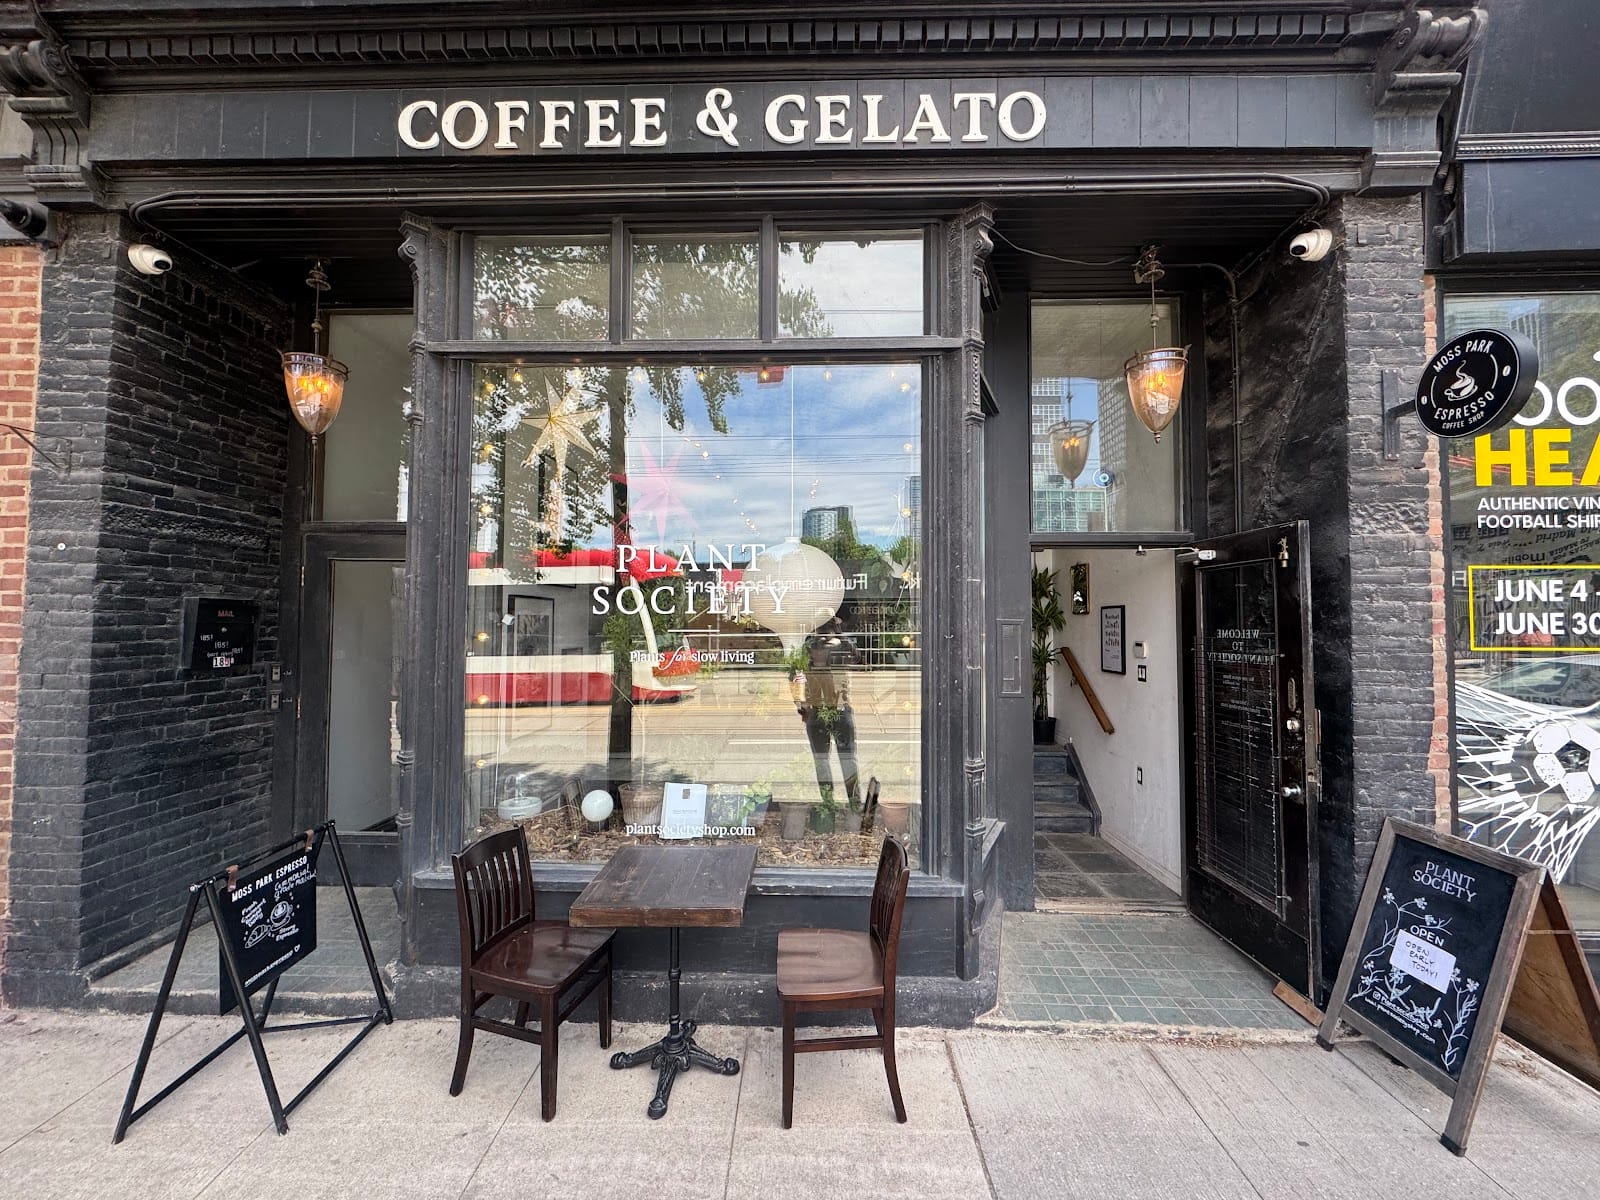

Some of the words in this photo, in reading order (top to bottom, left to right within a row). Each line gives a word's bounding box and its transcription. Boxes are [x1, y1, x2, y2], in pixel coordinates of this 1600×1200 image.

[397, 97, 668, 150] COFFEE
[695, 87, 740, 147] &
[764, 90, 1047, 145] GELATO
[1432, 345, 1462, 373] MOSS
[1465, 339, 1494, 354] PARK
[1433, 390, 1495, 421] ESPRESSO
[1512, 376, 1600, 426] OO
[1441, 420, 1465, 430] COFFEE
[1468, 411, 1485, 425] SHOP
[1477, 496, 1570, 511] AUTHENTIC
[1477, 514, 1564, 529] FOOTBALL
[615, 543, 767, 573] PLANT
[591, 585, 791, 615] SOCIETY
[1495, 579, 1564, 603] JUNE
[1569, 579, 1588, 603] 4
[1495, 612, 1565, 635] JUNE
[629, 650, 666, 663] Plants
[691, 650, 719, 663] slow
[720, 650, 755, 664] living
[625, 822, 756, 837] plantsocietyshop.com
[231, 883, 253, 903] MOSS
[255, 872, 273, 891] PARK
[275, 855, 308, 880] ESPRESSO
[1412, 869, 1477, 903] SOCIETY
[1425, 861, 1475, 890] PLANT
[1410, 924, 1445, 947] OPEN
[1405, 940, 1430, 957] OPEN
[1409, 950, 1436, 968] EARLY
[1411, 960, 1438, 979] TODAY!
